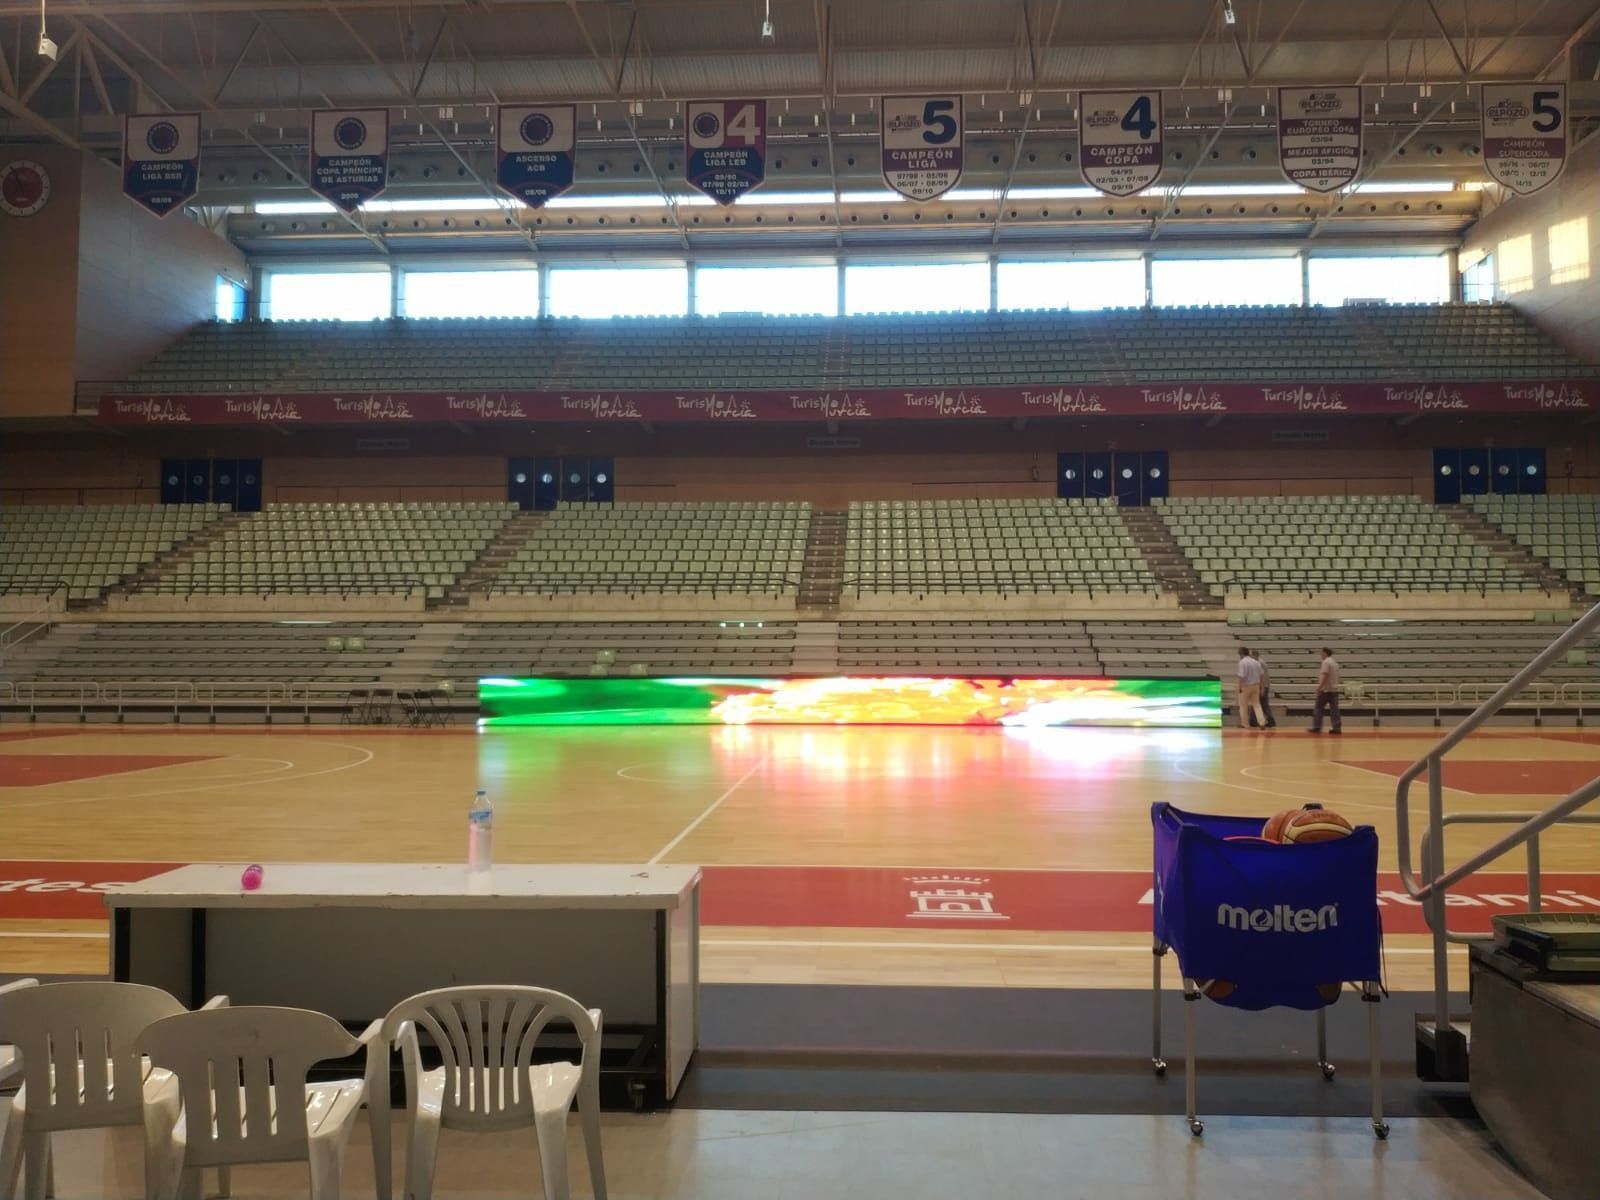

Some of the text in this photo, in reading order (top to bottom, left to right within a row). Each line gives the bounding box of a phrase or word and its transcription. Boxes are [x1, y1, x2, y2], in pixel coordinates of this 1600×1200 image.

[1532, 92, 1561, 132] 5
[922, 100, 957, 144] 5
[1121, 96, 1157, 140] 4
[726, 104, 760, 144] 4
[1503, 139, 1545, 148] CAMPEÓN
[704, 150, 748, 158] CAMPEÓN
[1090, 144, 1153, 156] CAMPEÓN
[892, 149, 953, 160] CAMPEÓN
[329, 158, 371, 166] CAMPEÓN
[908, 160, 937, 168] LIGA
[1105, 156, 1139, 164] COPA
[141, 162, 183, 170] CAMPEÓN
[343, 166, 383, 174] PRÍNCIPE
[1319, 169, 1352, 177] IBÉRICA
[336, 175, 378, 183] ASTURIAS
[1216, 903, 1338, 932] molten
